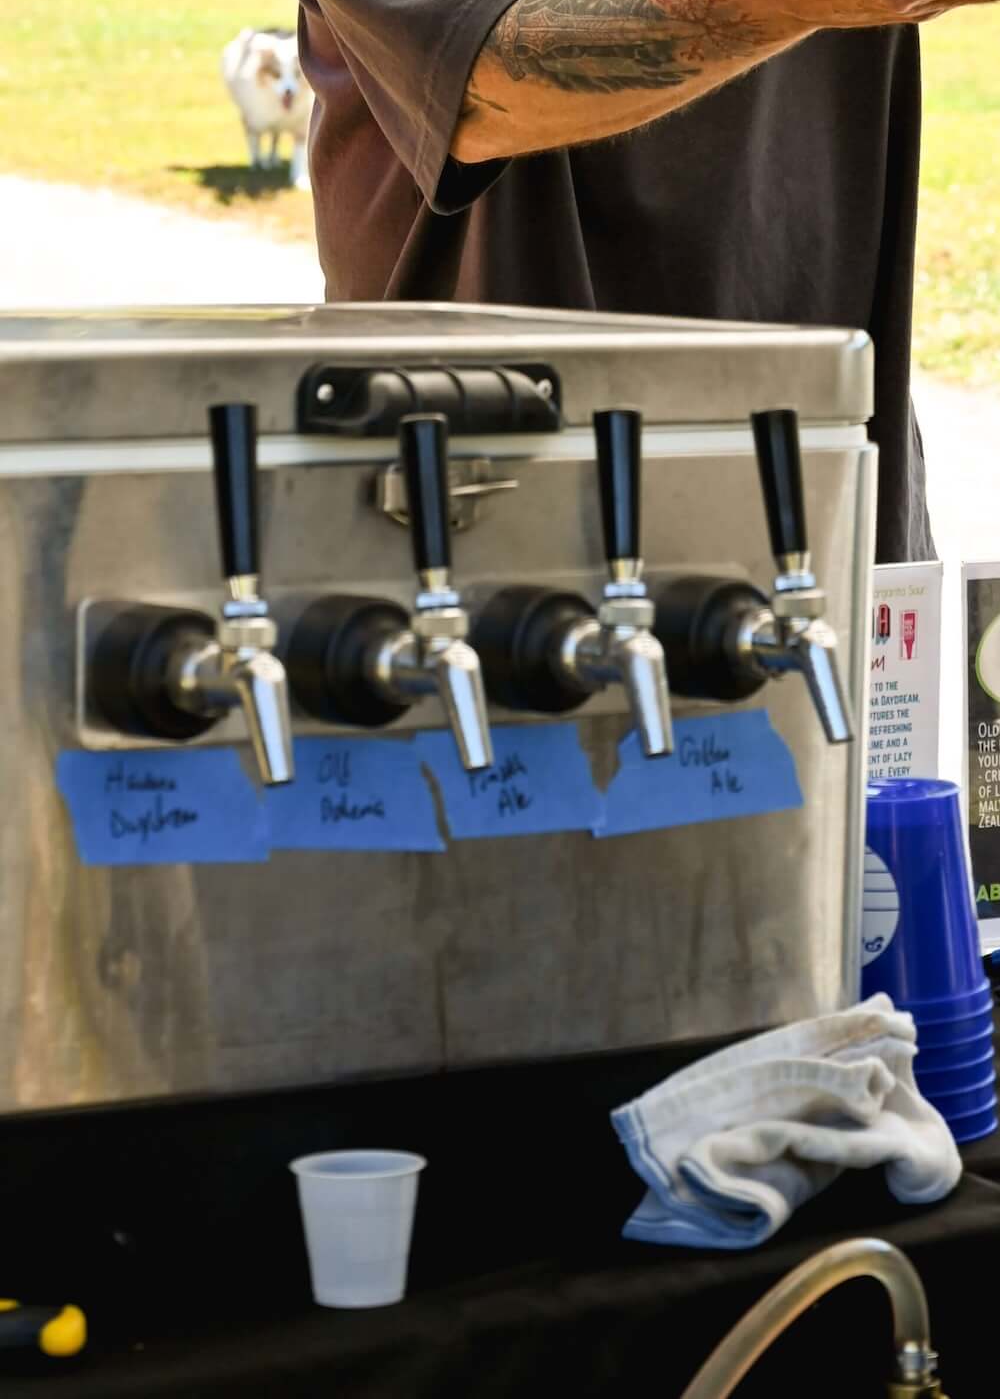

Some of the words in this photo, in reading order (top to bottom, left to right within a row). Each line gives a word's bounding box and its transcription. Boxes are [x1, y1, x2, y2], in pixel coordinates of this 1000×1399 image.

[875, 682, 884, 692] TO
[886, 681, 898, 691] THE
[897, 709, 910, 718] THE
[978, 722, 999, 738] OLD
[886, 739, 901, 748] AND
[903, 737, 908, 746] A
[978, 740, 996, 753] THE
[883, 754, 892, 763] OF
[894, 752, 912, 762] LAZY
[978, 785, 992, 798] OF
